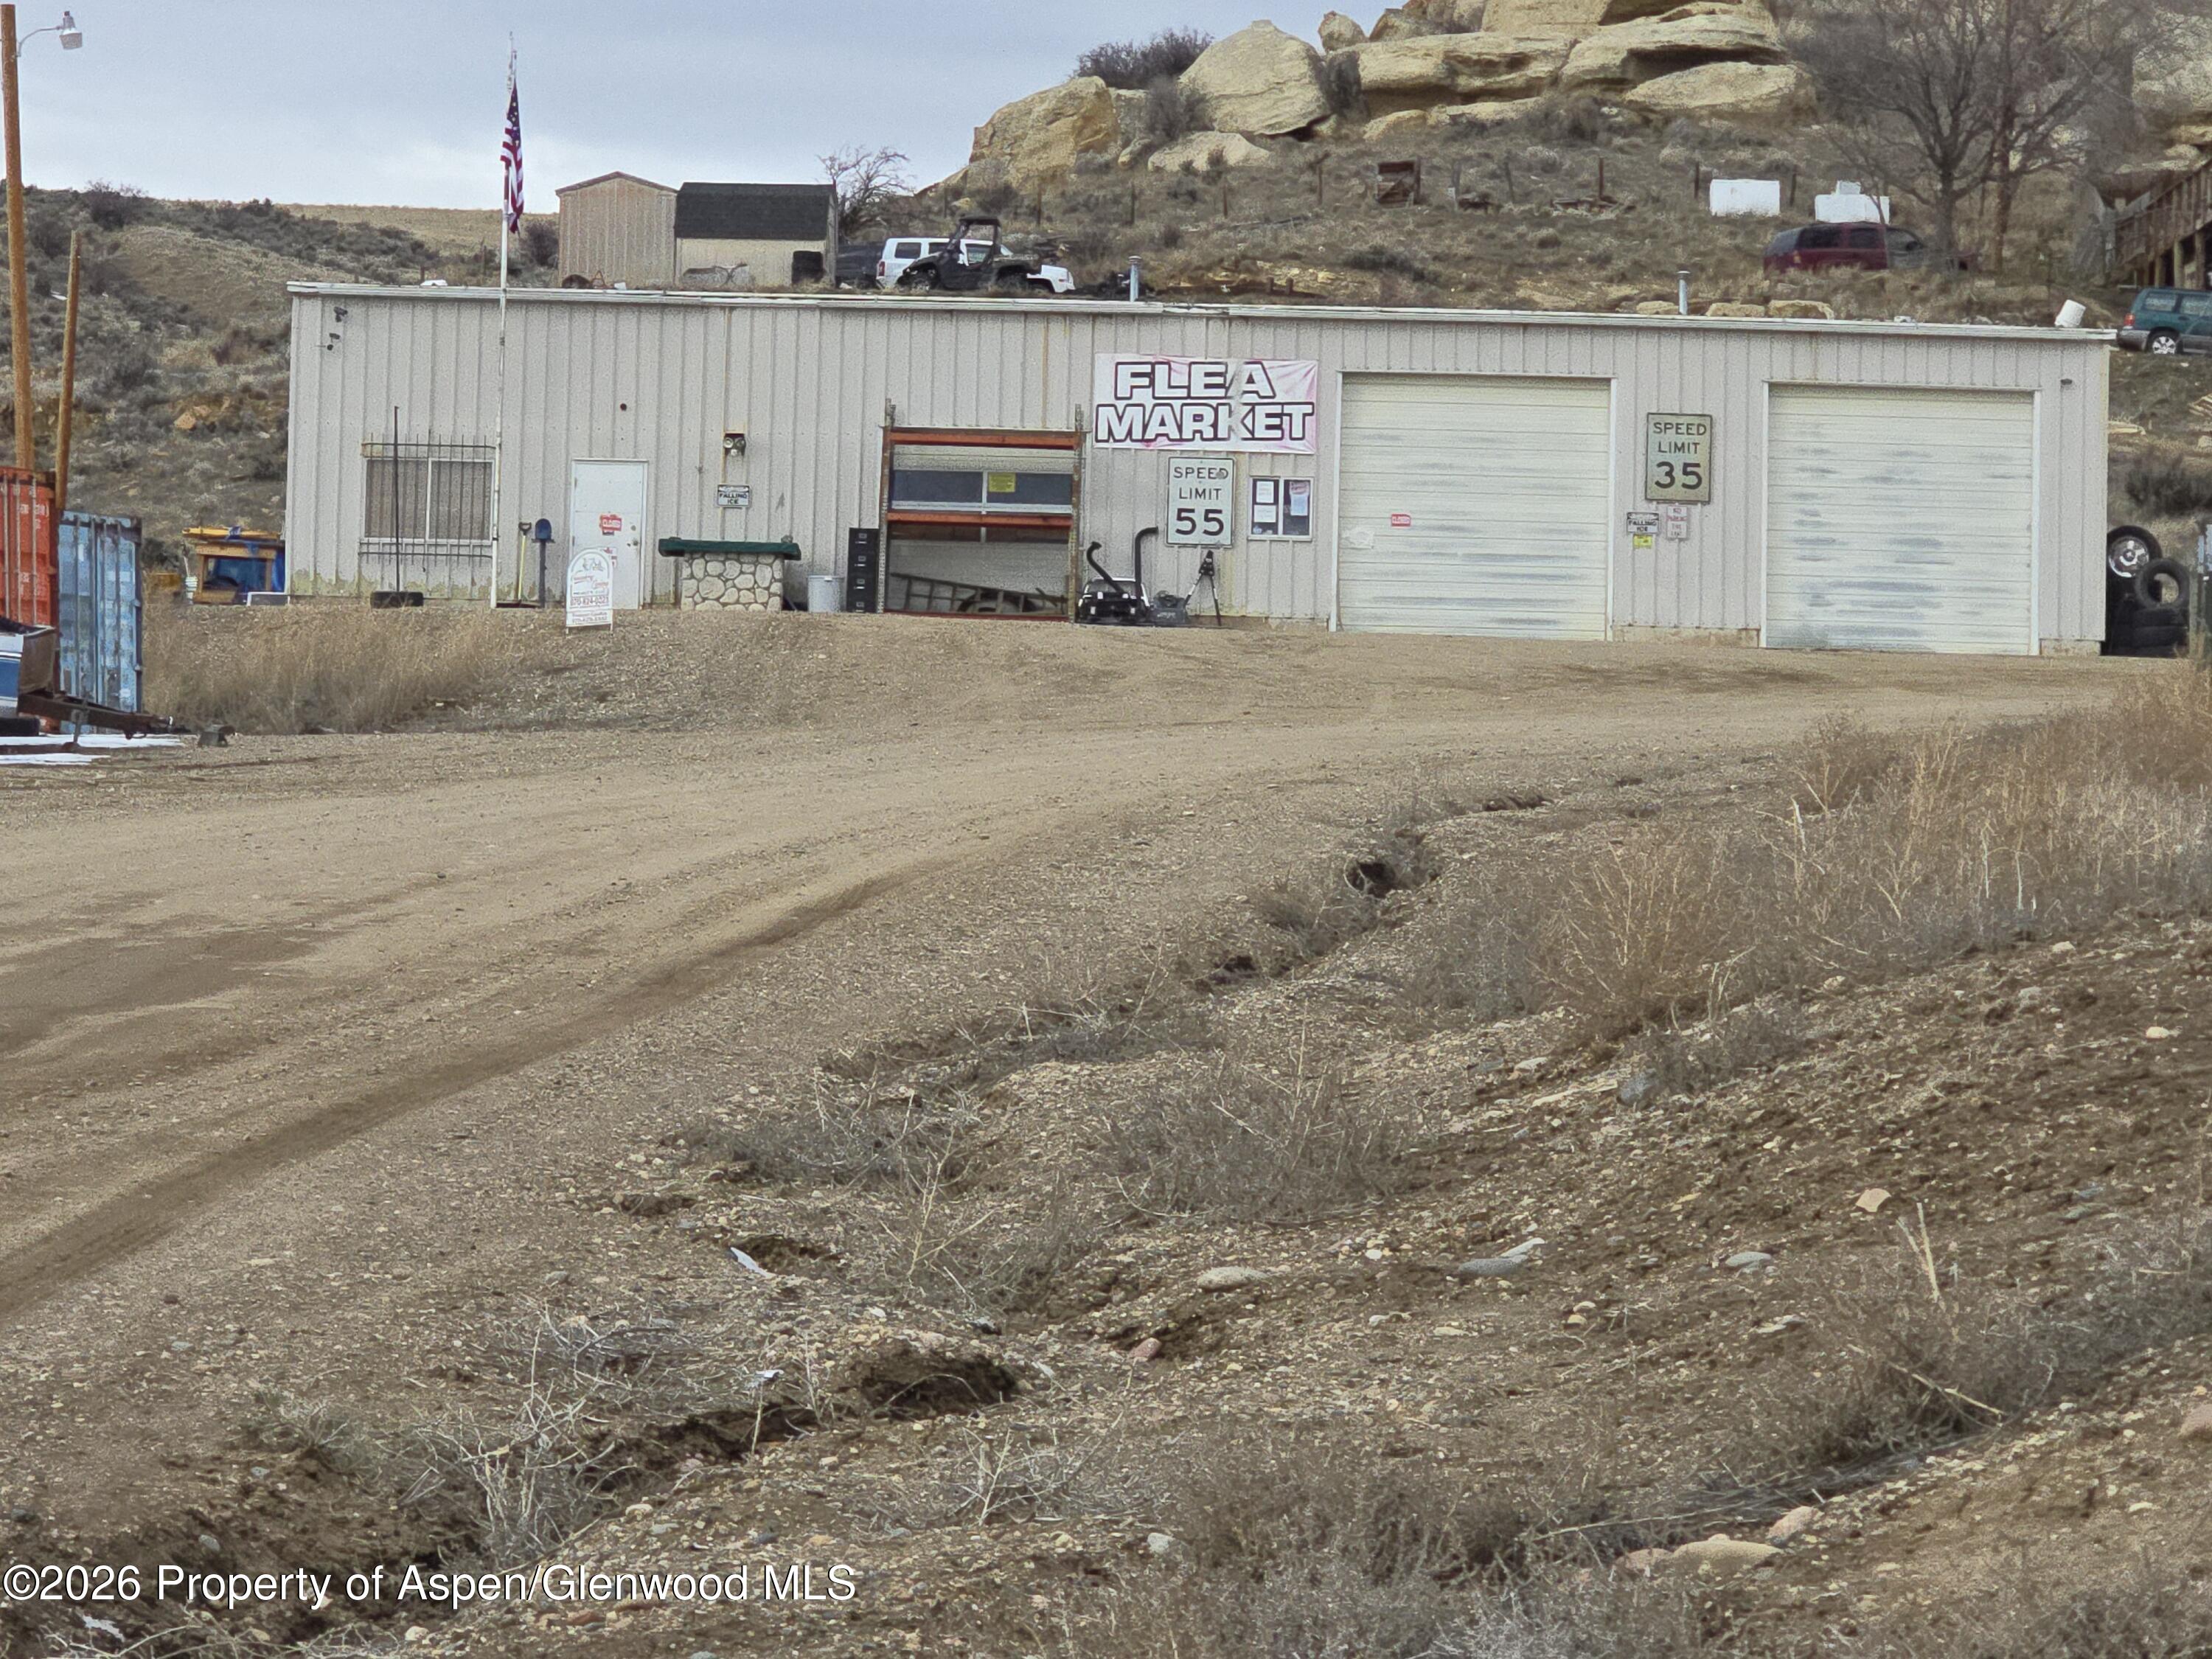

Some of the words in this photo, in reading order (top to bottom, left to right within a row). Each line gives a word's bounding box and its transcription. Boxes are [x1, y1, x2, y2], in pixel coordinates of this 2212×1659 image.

[1114, 361, 1276, 400] FLEA
[1095, 401, 1315, 443] MARKET
[1653, 422, 1707, 436] SPEED
[1658, 441, 1700, 454] LIMIT
[1173, 466, 1229, 479] SPEED
[1655, 461, 1703, 490] 35
[1179, 487, 1222, 501] LIMIT
[1175, 508, 1225, 536] 55
